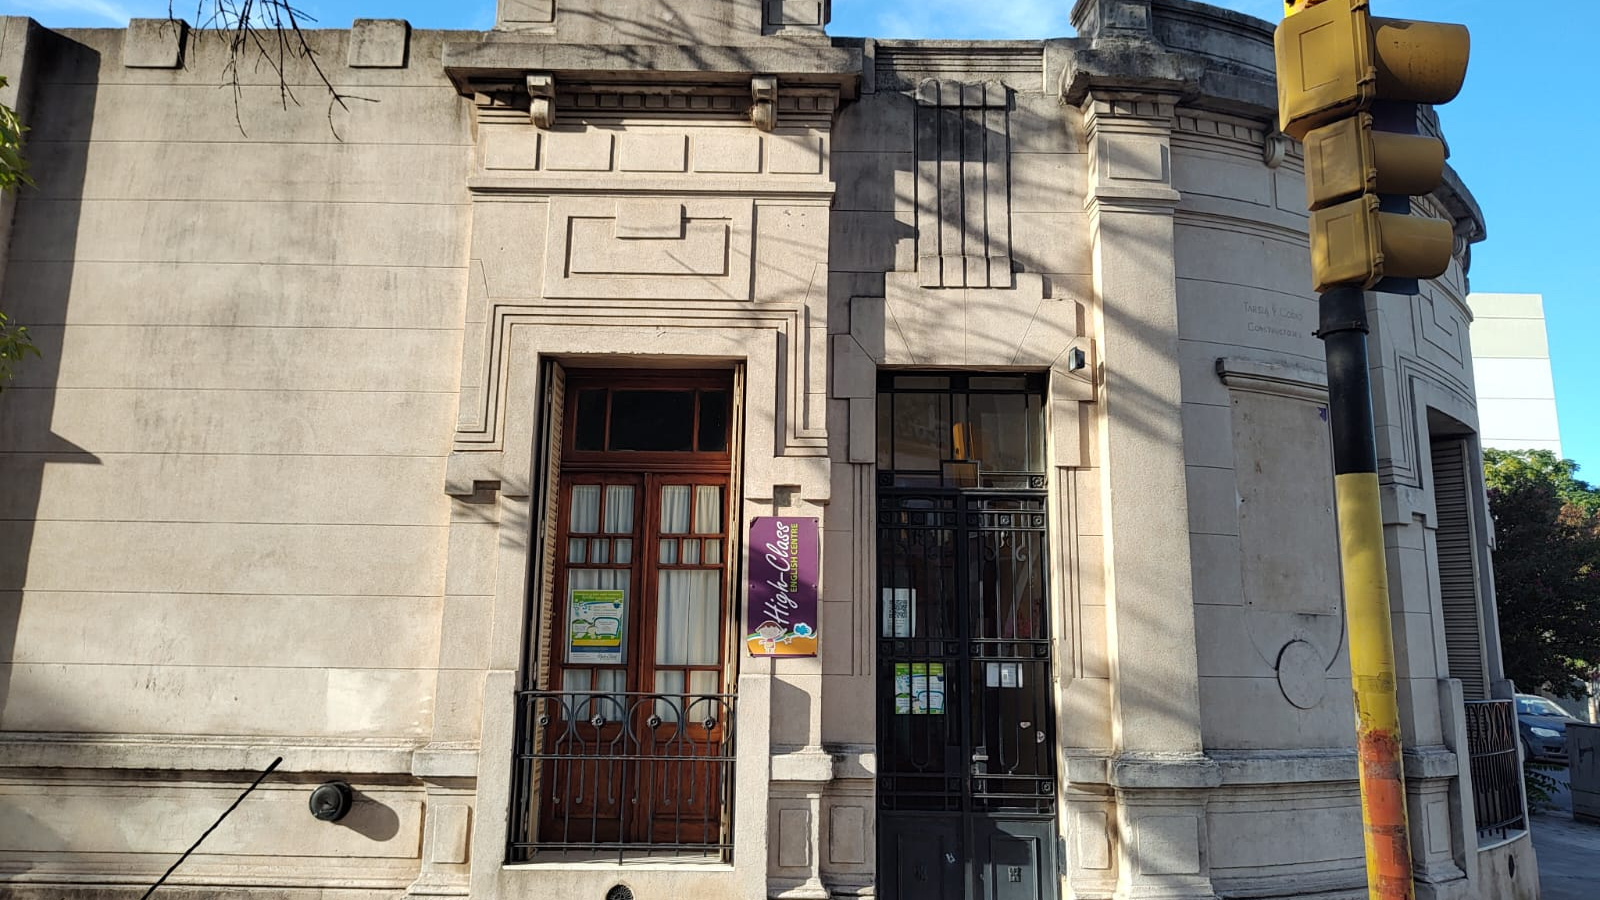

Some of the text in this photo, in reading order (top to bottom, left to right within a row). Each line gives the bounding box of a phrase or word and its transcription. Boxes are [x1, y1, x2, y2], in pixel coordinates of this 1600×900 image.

[763, 521, 798, 624] High-Class
[790, 523, 798, 592] ENGLISH CENTRE
